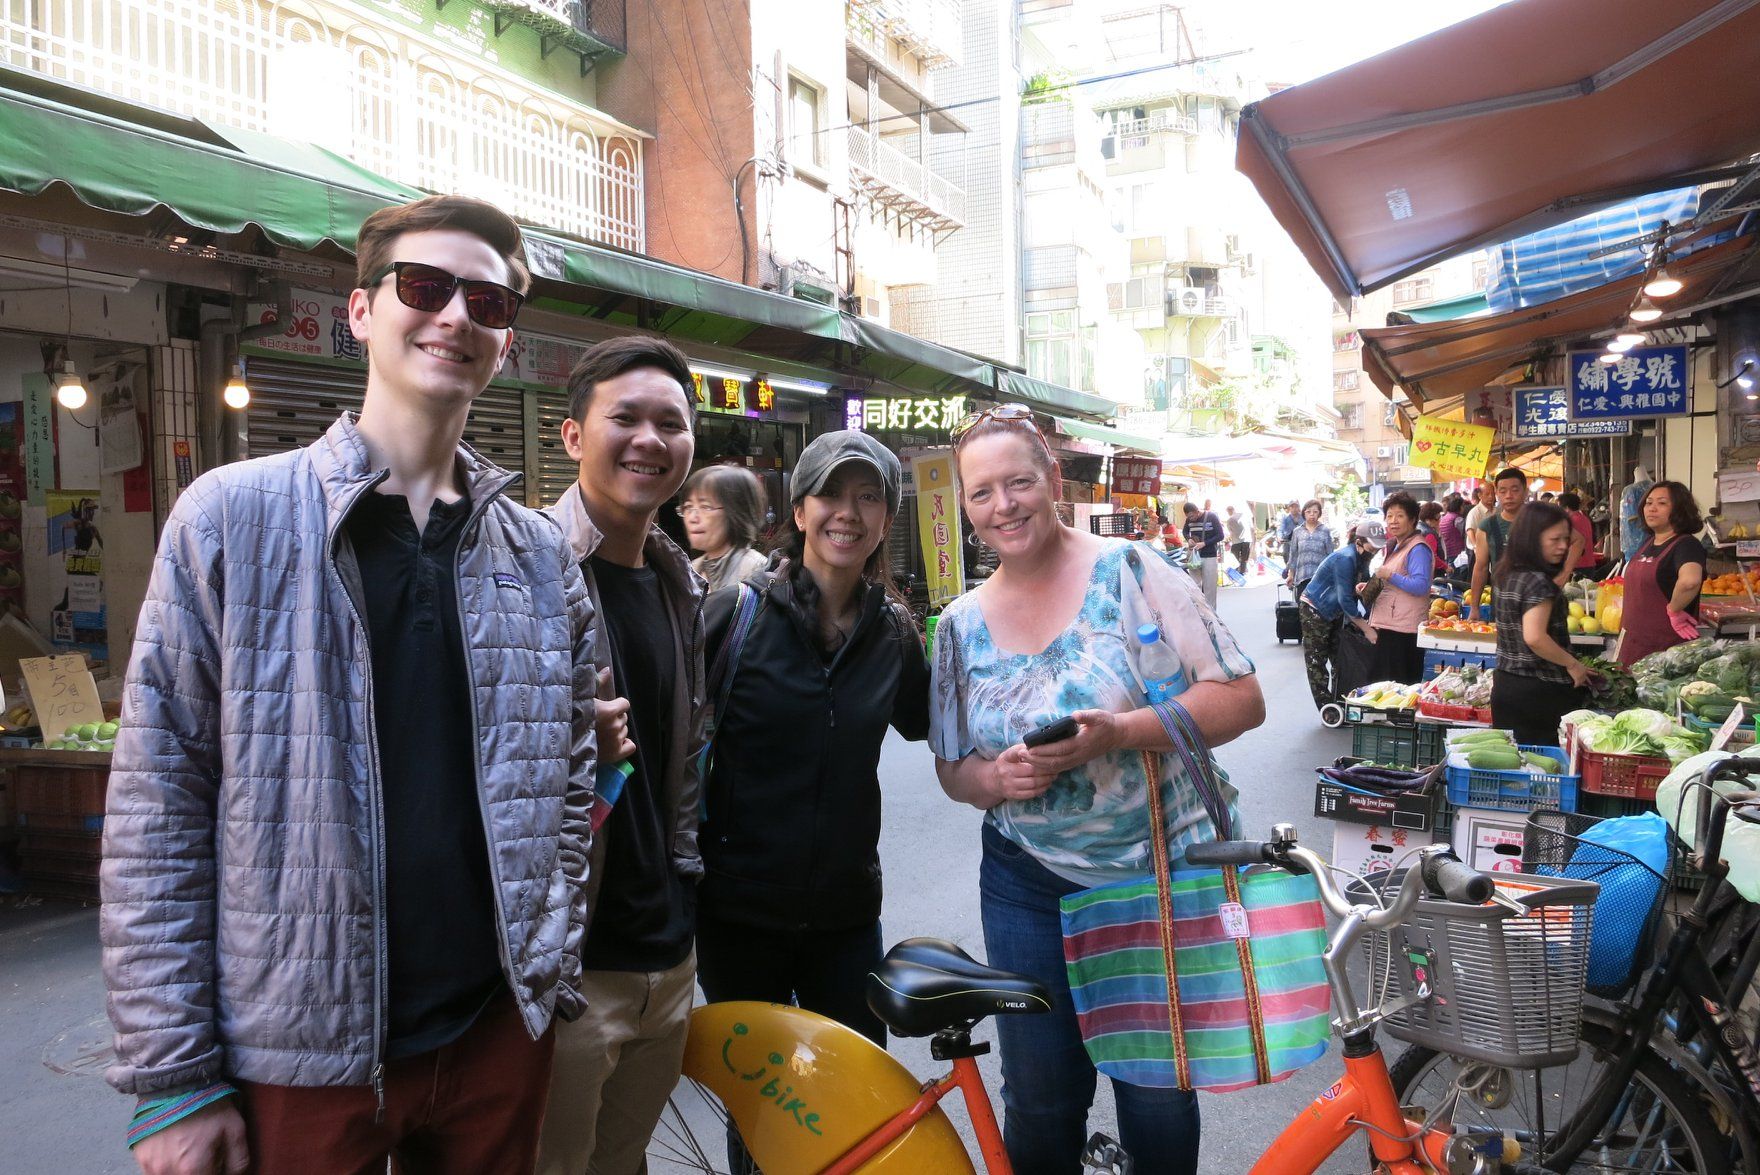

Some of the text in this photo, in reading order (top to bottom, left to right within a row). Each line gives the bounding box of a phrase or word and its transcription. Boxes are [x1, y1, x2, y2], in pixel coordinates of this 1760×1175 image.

[1577, 353, 1681, 393] 繡學號
[863, 396, 967, 429] 同好交流
[1005, 1001, 1026, 1009] VELO
